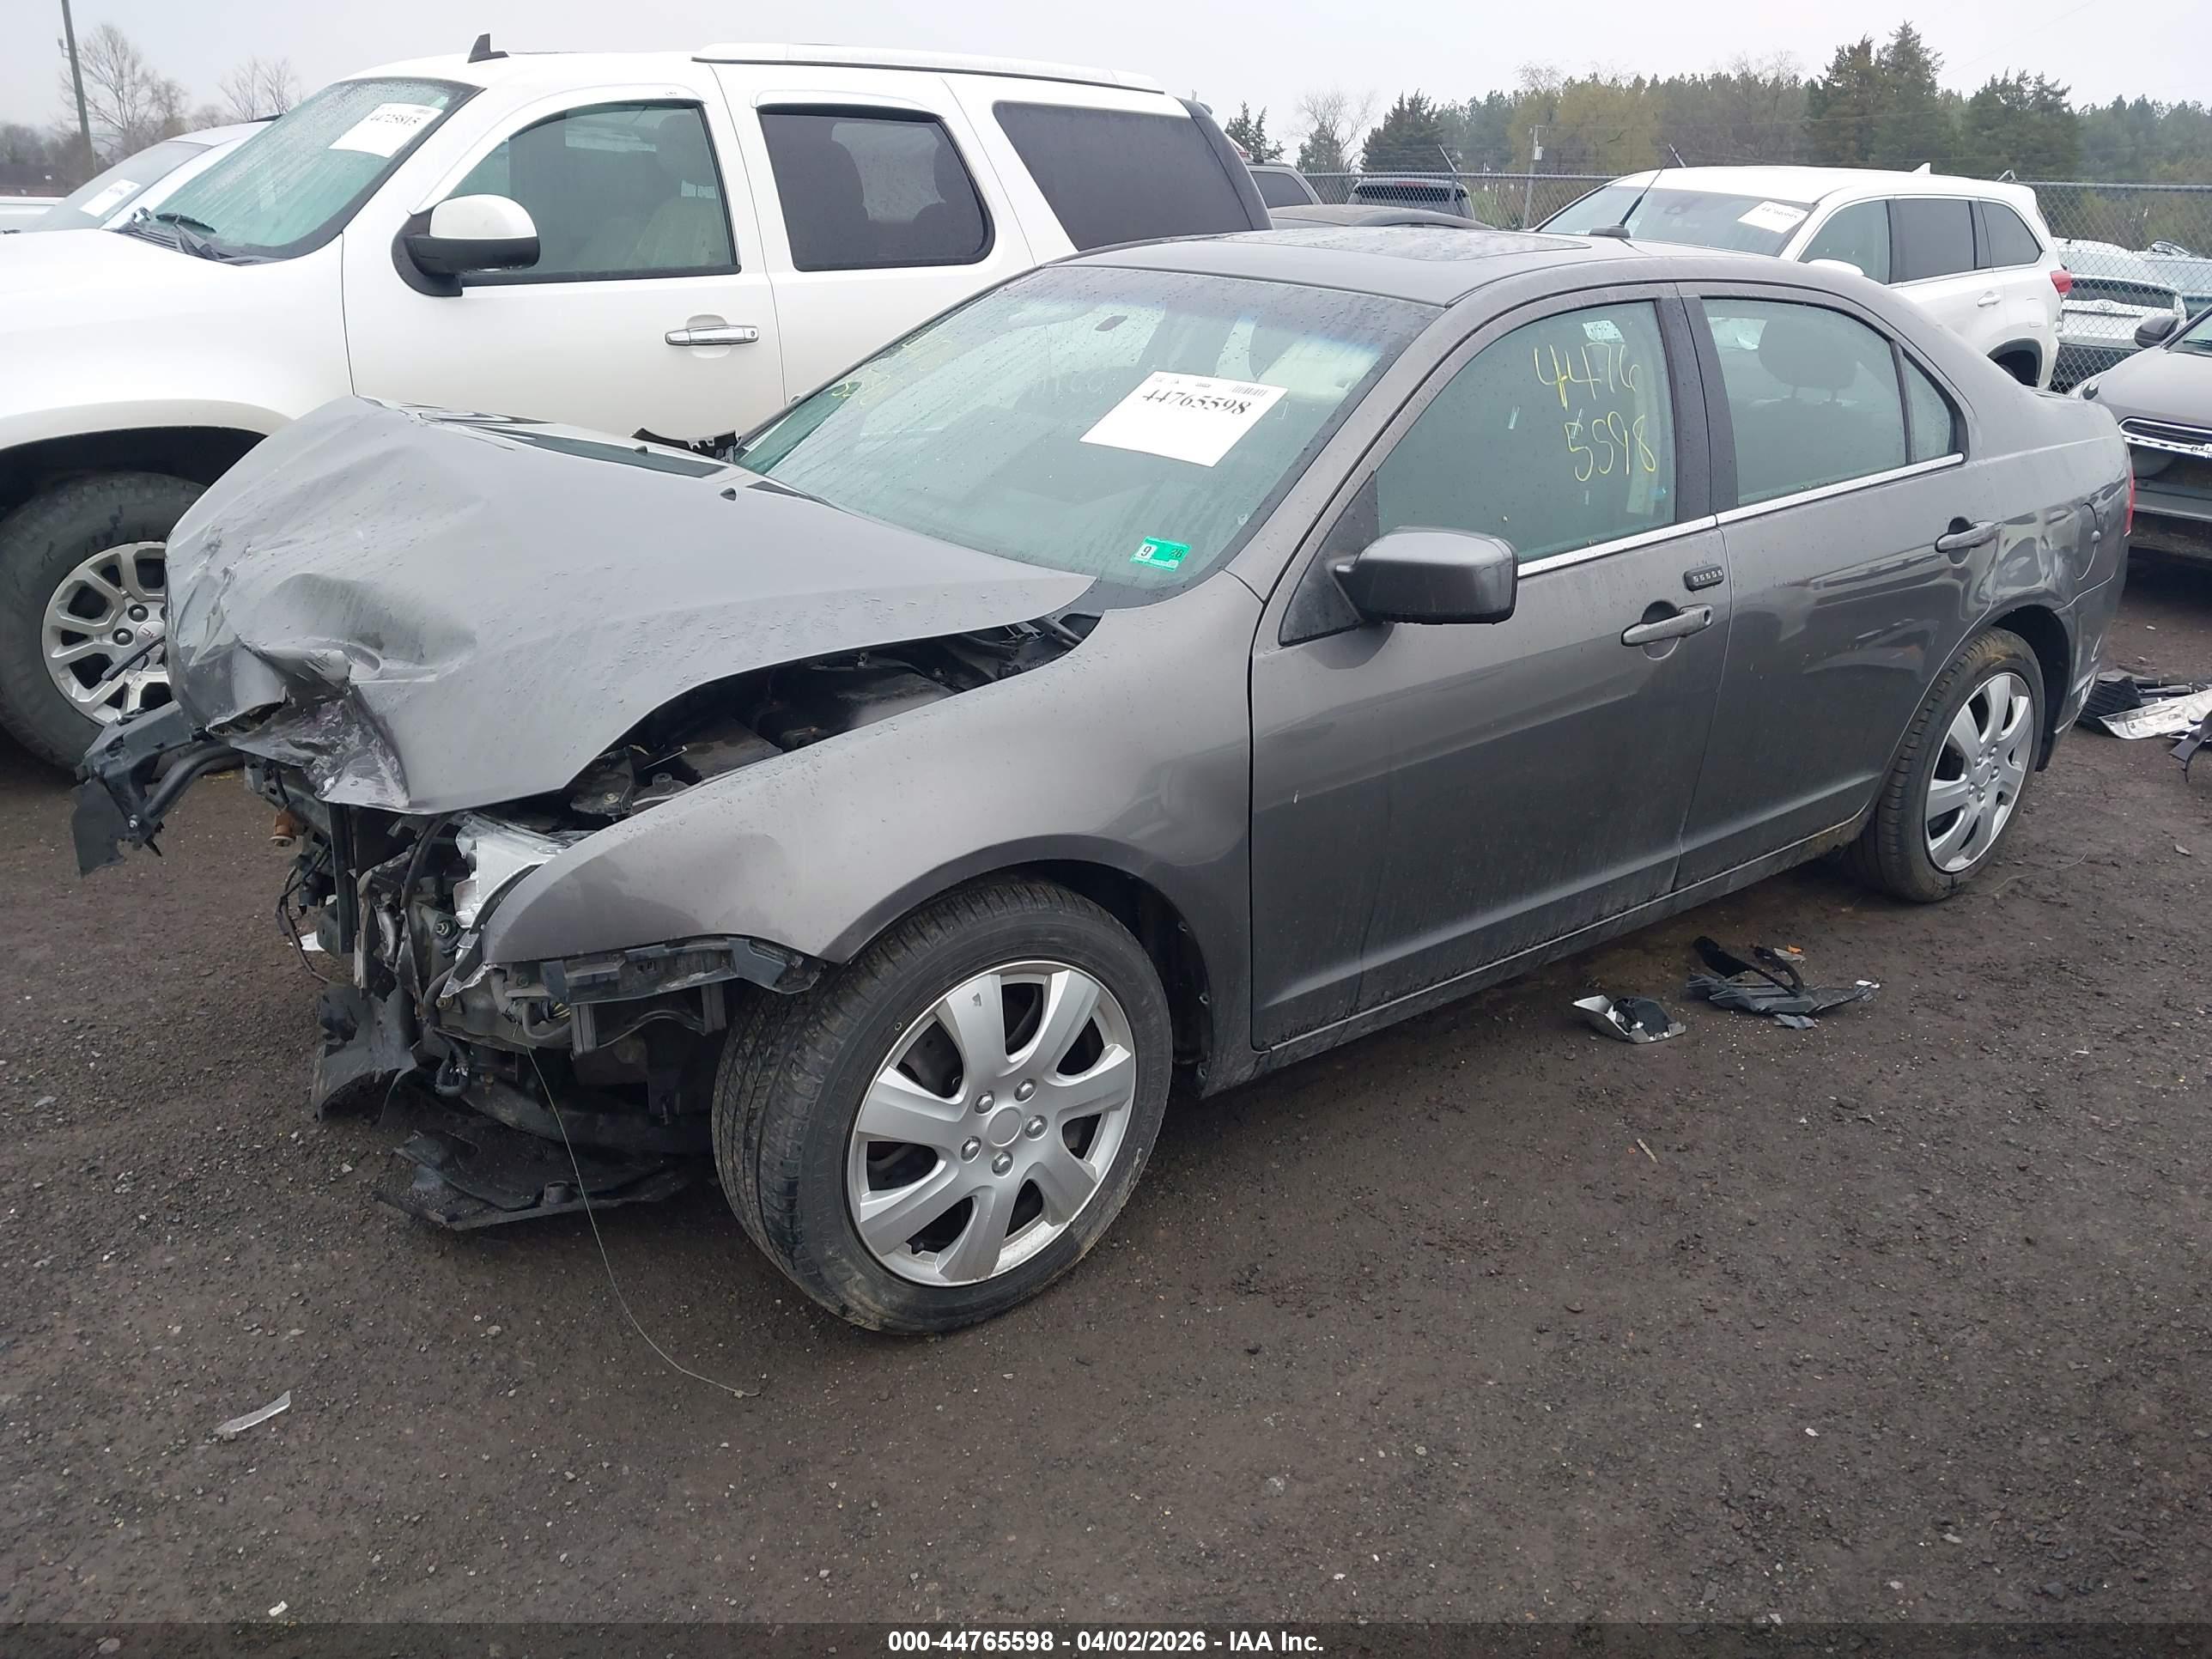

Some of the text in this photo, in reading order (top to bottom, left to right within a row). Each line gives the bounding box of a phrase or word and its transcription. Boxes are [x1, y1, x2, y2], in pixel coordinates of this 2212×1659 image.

[1534, 343, 1641, 411] 4476
[1142, 388, 1251, 416] 44765598
[1564, 410, 1656, 482] 5598
[1140, 545, 1184, 558] 9 26
